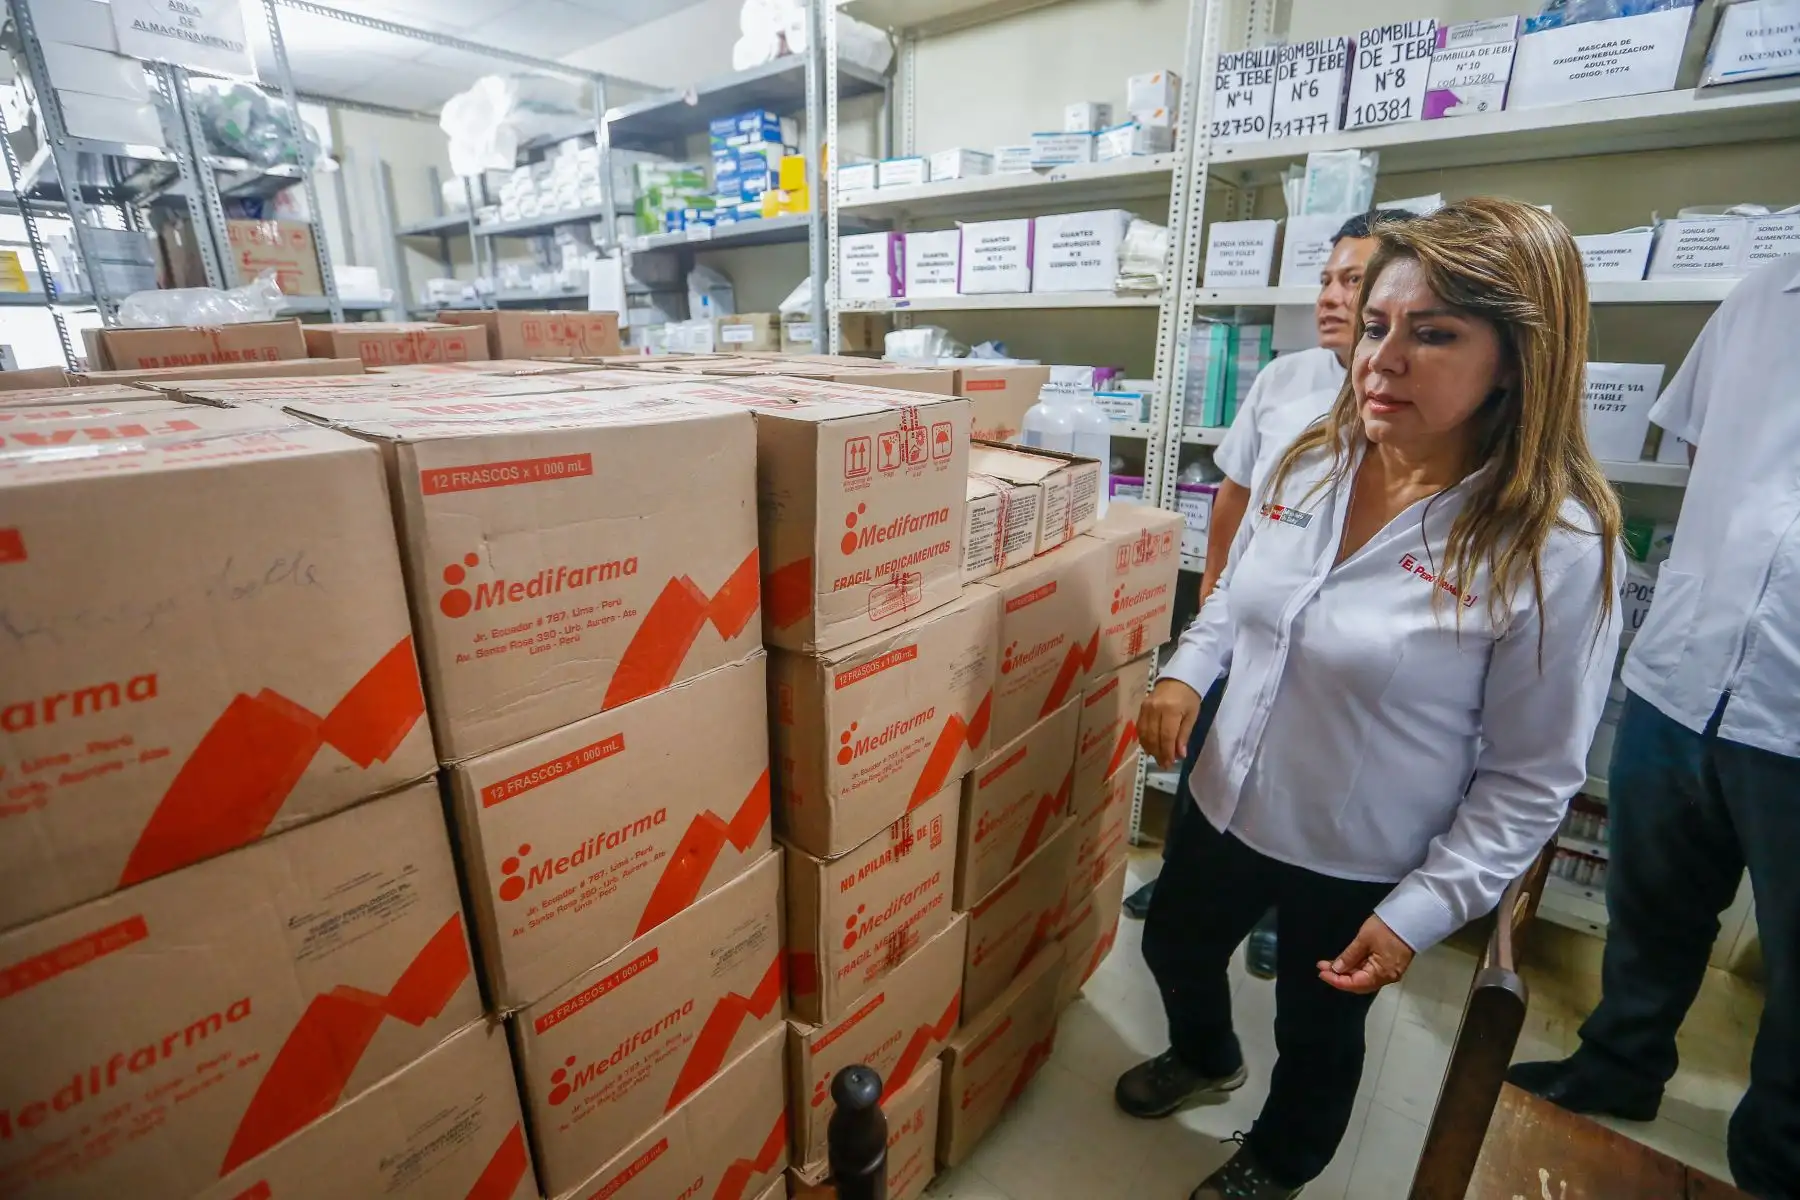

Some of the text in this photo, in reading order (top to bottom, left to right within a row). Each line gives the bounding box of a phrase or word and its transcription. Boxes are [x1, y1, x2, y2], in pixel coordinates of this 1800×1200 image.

[1360, 19, 1437, 48] BOMBILLA
[1578, 41, 1618, 53] MASCARA
[1280, 37, 1345, 62] BOMBILLA
[1360, 48, 1382, 69] DE
[1478, 48, 1490, 57] DE
[1553, 54, 1590, 66] OXIGENO
[1584, 59, 1618, 69] ADULTO
[1216, 69, 1273, 91] DE JEBE
[1279, 52, 1345, 81] DE JEBE
[1463, 73, 1495, 86] 15280
[1568, 66, 1631, 80] CODIGO: 16774
[1273, 113, 1329, 139] 31777
[1354, 97, 1413, 126] 10381
[1210, 115, 1265, 138] 32750
[1589, 383, 1644, 392] TRIPLE VIA
[432, 475, 448, 488] 12
[452, 465, 520, 488] FRASCOS
[568, 458, 587, 472] mL
[858, 507, 950, 550] Medifarma
[833, 541, 951, 592] FRAGIL MEDICAMENTOS
[474, 556, 639, 612] Medifarma
[473, 633, 488, 643] Jr.
[492, 621, 534, 638] Ecuador
[572, 606, 594, 618] Lima
[510, 637, 534, 650] Rosa
[529, 643, 552, 655] Lima
[840, 675, 847, 686] 12
[848, 662, 880, 681] FRASCOS
[854, 706, 936, 759] Medifarma
[491, 786, 505, 800] 12
[507, 762, 563, 794] FRASCOS
[602, 740, 619, 753] mL
[526, 807, 668, 891] Medifarma
[840, 874, 855, 894] NO
[858, 849, 892, 883] APILAR
[916, 824, 928, 842] DE
[857, 871, 941, 940] Medifarma
[837, 948, 872, 981] FRAGIL
[874, 893, 944, 951] MEDICAMENTOS
[544, 1014, 555, 1026] 12
[556, 984, 605, 1018] FRASCOS
[572, 999, 695, 1092] Medifarma
